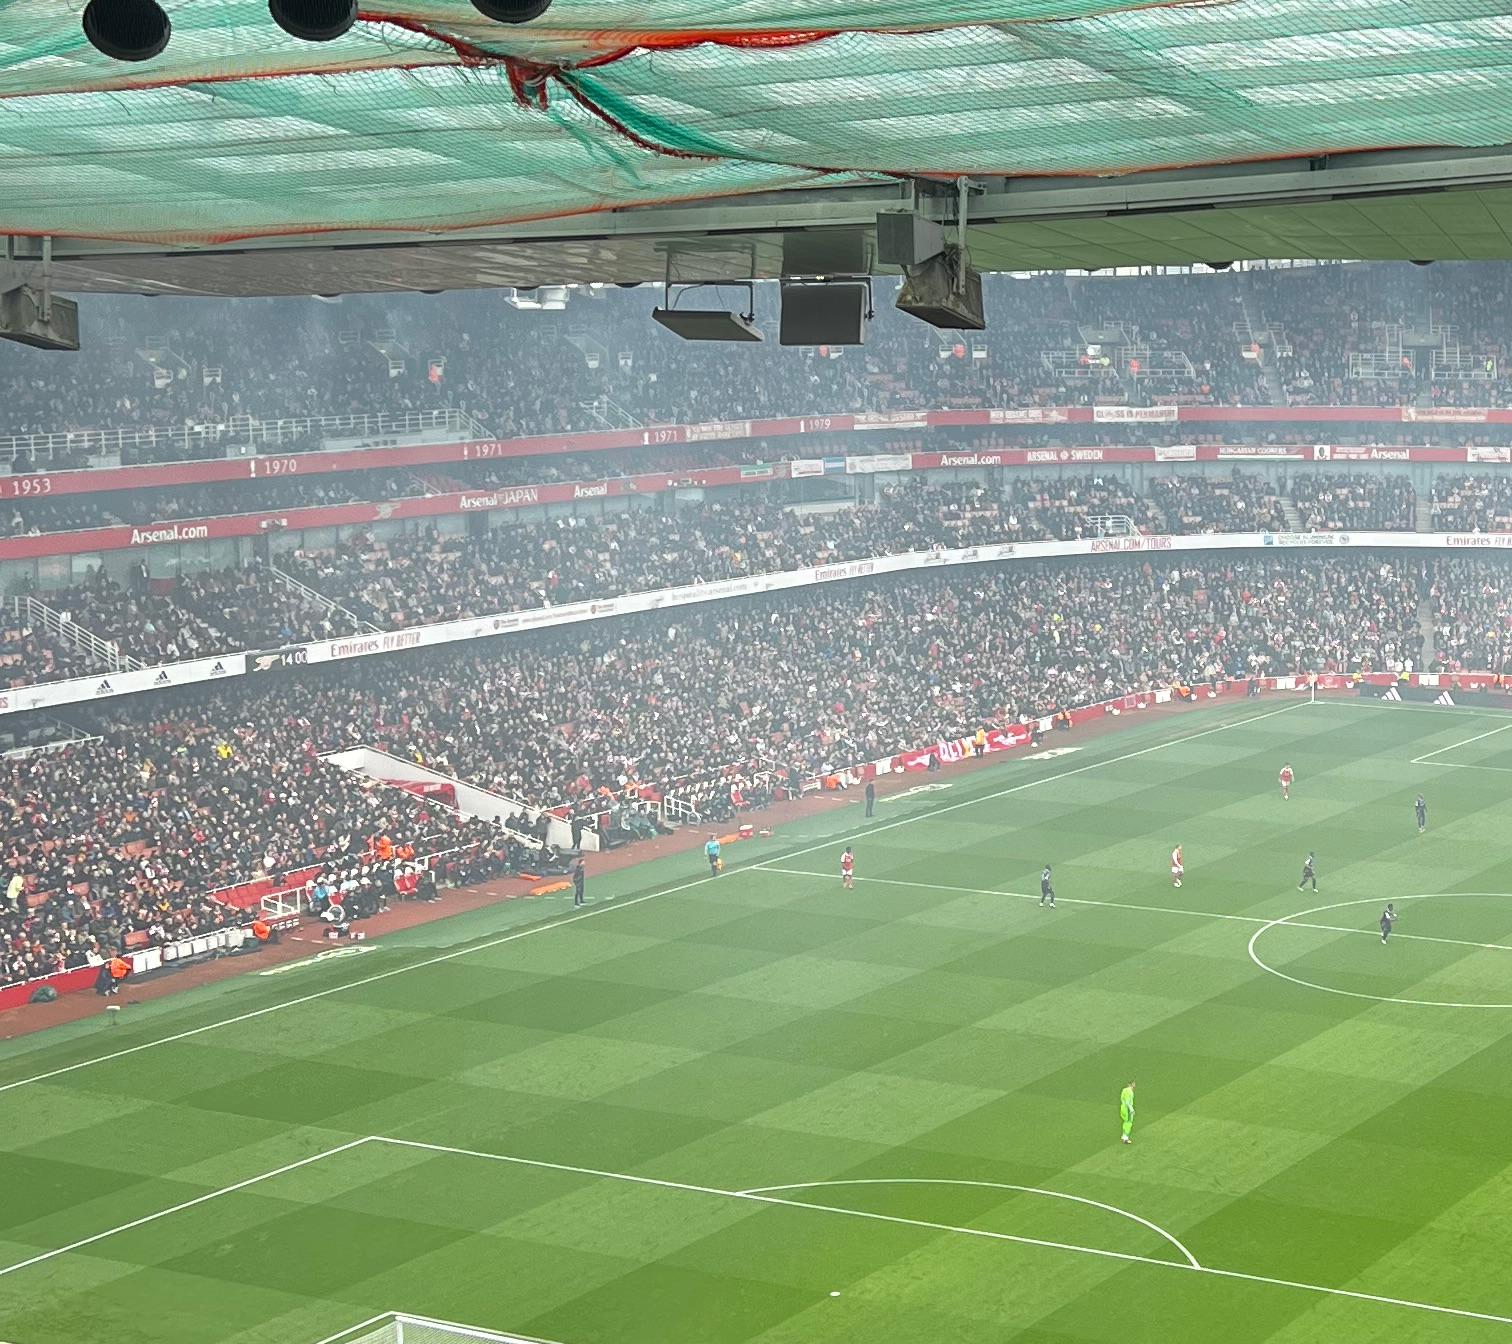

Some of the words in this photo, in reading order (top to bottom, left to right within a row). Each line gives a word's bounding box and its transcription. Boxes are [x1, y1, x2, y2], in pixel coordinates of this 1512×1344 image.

[808, 419, 831, 431] 1979
[654, 430, 678, 443] 1971
[476, 444, 502, 457] 1971
[1370, 447, 1409, 460] Arsenal
[264, 459, 297, 475] 1970
[940, 453, 1001, 467] Arsenal.com
[12, 477, 51, 496] 1953
[574, 482, 607, 498] Arsenal
[459, 493, 498, 509] Arsenal
[502, 488, 539, 504] JAPAN
[131, 524, 208, 546] Arsenal.com
[1446, 535, 1491, 546] Emirates
[330, 639, 379, 658] Emirates
